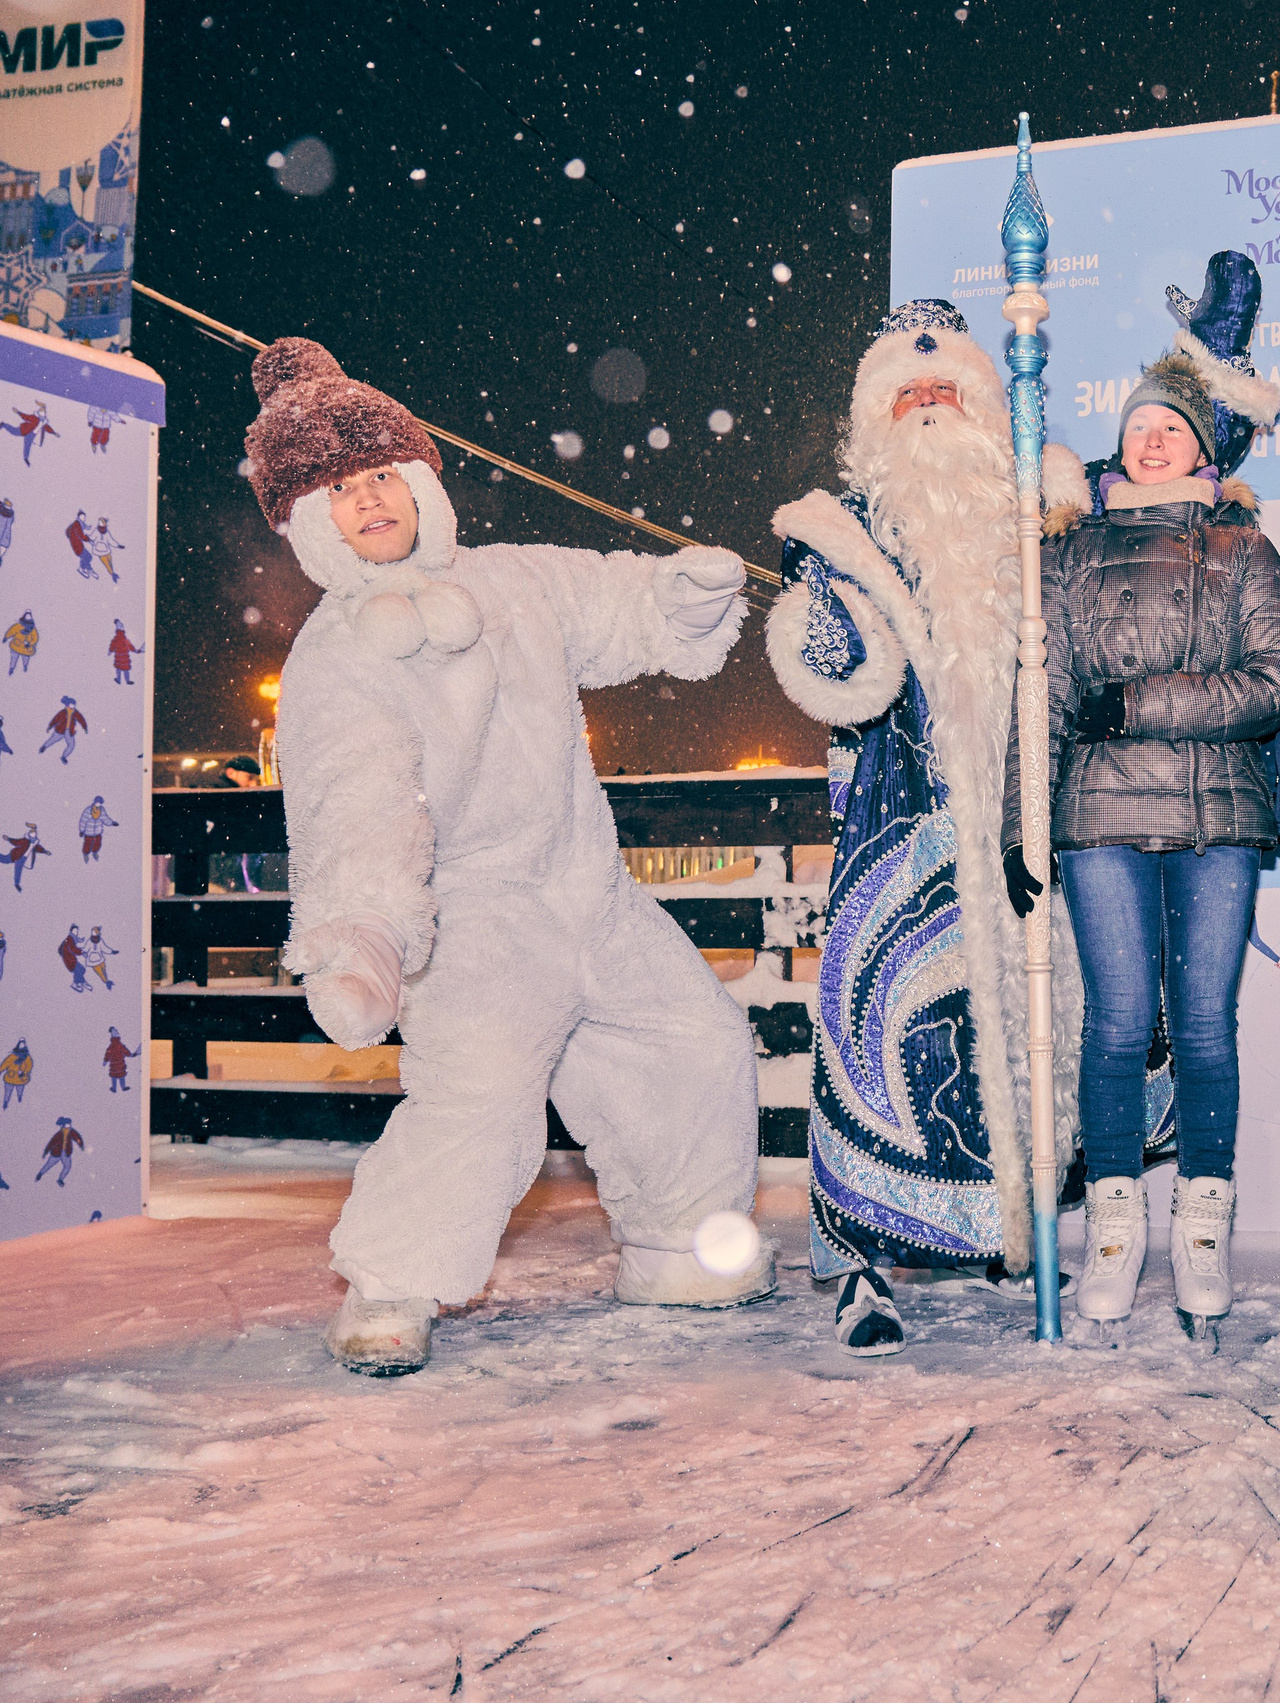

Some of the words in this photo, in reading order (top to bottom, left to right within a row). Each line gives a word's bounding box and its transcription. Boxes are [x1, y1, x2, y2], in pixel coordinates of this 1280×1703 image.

[0, 18, 125, 74] МИР
[0, 84, 63, 99] атёжная
[67, 77, 123, 93] система
[952, 264, 1011, 284] ЛИНИ
[1042, 254, 1099, 275] ИЗНИ
[952, 278, 1066, 299] благотворный
[1068, 276, 1100, 290] фонд
